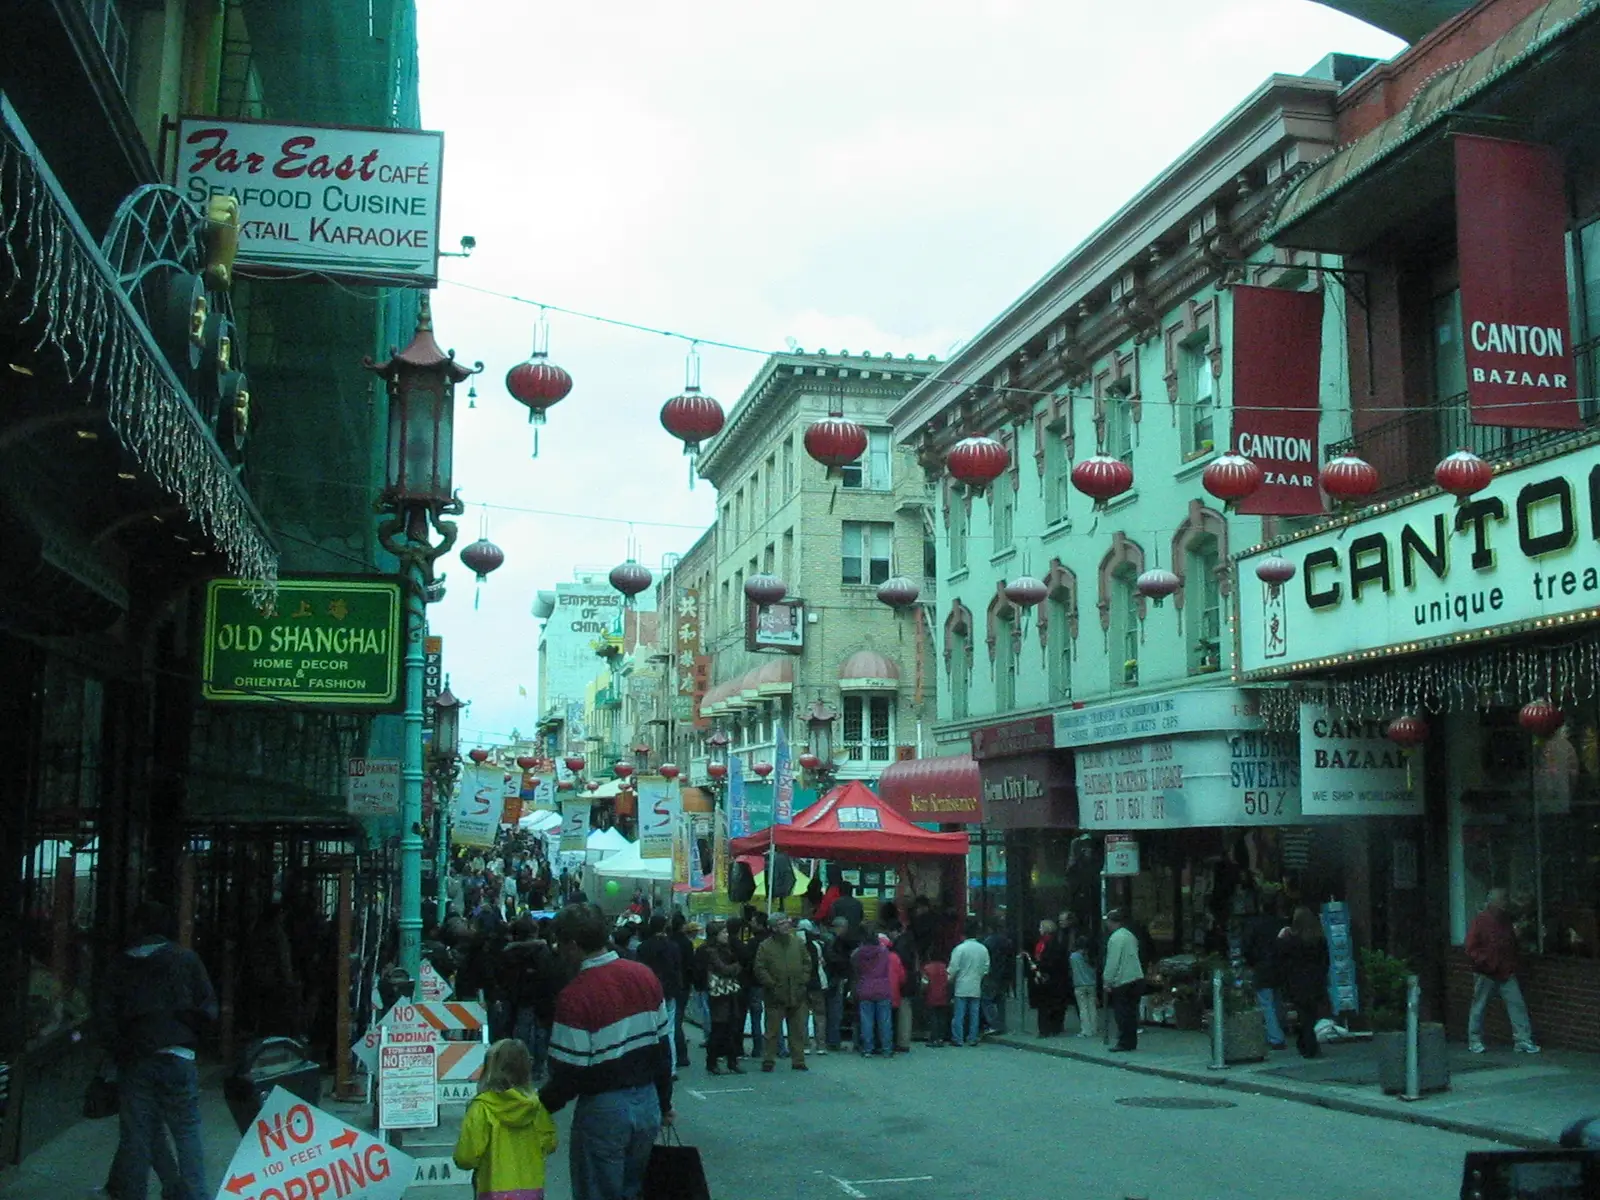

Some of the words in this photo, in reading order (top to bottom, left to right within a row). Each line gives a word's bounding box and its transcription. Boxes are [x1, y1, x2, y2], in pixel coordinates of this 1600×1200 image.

[186, 129, 265, 175] Far
[272, 136, 379, 182] East
[379, 163, 429, 185] CAFÉ
[186, 176, 311, 210] SEAFOOD
[322, 185, 427, 217] CUISINE
[239, 220, 298, 241] KTAIL
[310, 217, 429, 249] KARAOKE
[1470, 320, 1564, 358] CANTON
[1472, 367, 1568, 389] BAZAAR
[1237, 431, 1312, 463] CANTON
[1263, 471, 1314, 488] ZAAR
[557, 594, 620, 607] EMPRESS
[1414, 586, 1504, 626] unique
[1533, 567, 1598, 601] trea
[581, 607, 599, 619] OF
[570, 621, 607, 633] CHINA
[218, 624, 263, 652] OLD
[269, 625, 387, 655] SHANGHAI
[253, 658, 293, 669] HOME
[301, 659, 349, 671] DECOR
[295, 668, 305, 678] &
[234, 676, 301, 688] ORIENTAL
[308, 678, 367, 690] FASHION
[426, 654, 438, 698] FOUR
[1313, 718, 1390, 740] CANT
[1230, 761, 1300, 789] SWEATS
[1312, 791, 1327, 801] WE
[393, 1006, 415, 1022] NO
[383, 1055, 398, 1067] NO
[399, 1054, 433, 1068] STOPPING
[387, 1046, 428, 1056] TOW-AWAY
[257, 1103, 315, 1158] NO
[262, 1159, 285, 1178] 100
[289, 1143, 323, 1167] FEET
[246, 1144, 391, 1200] PPING
